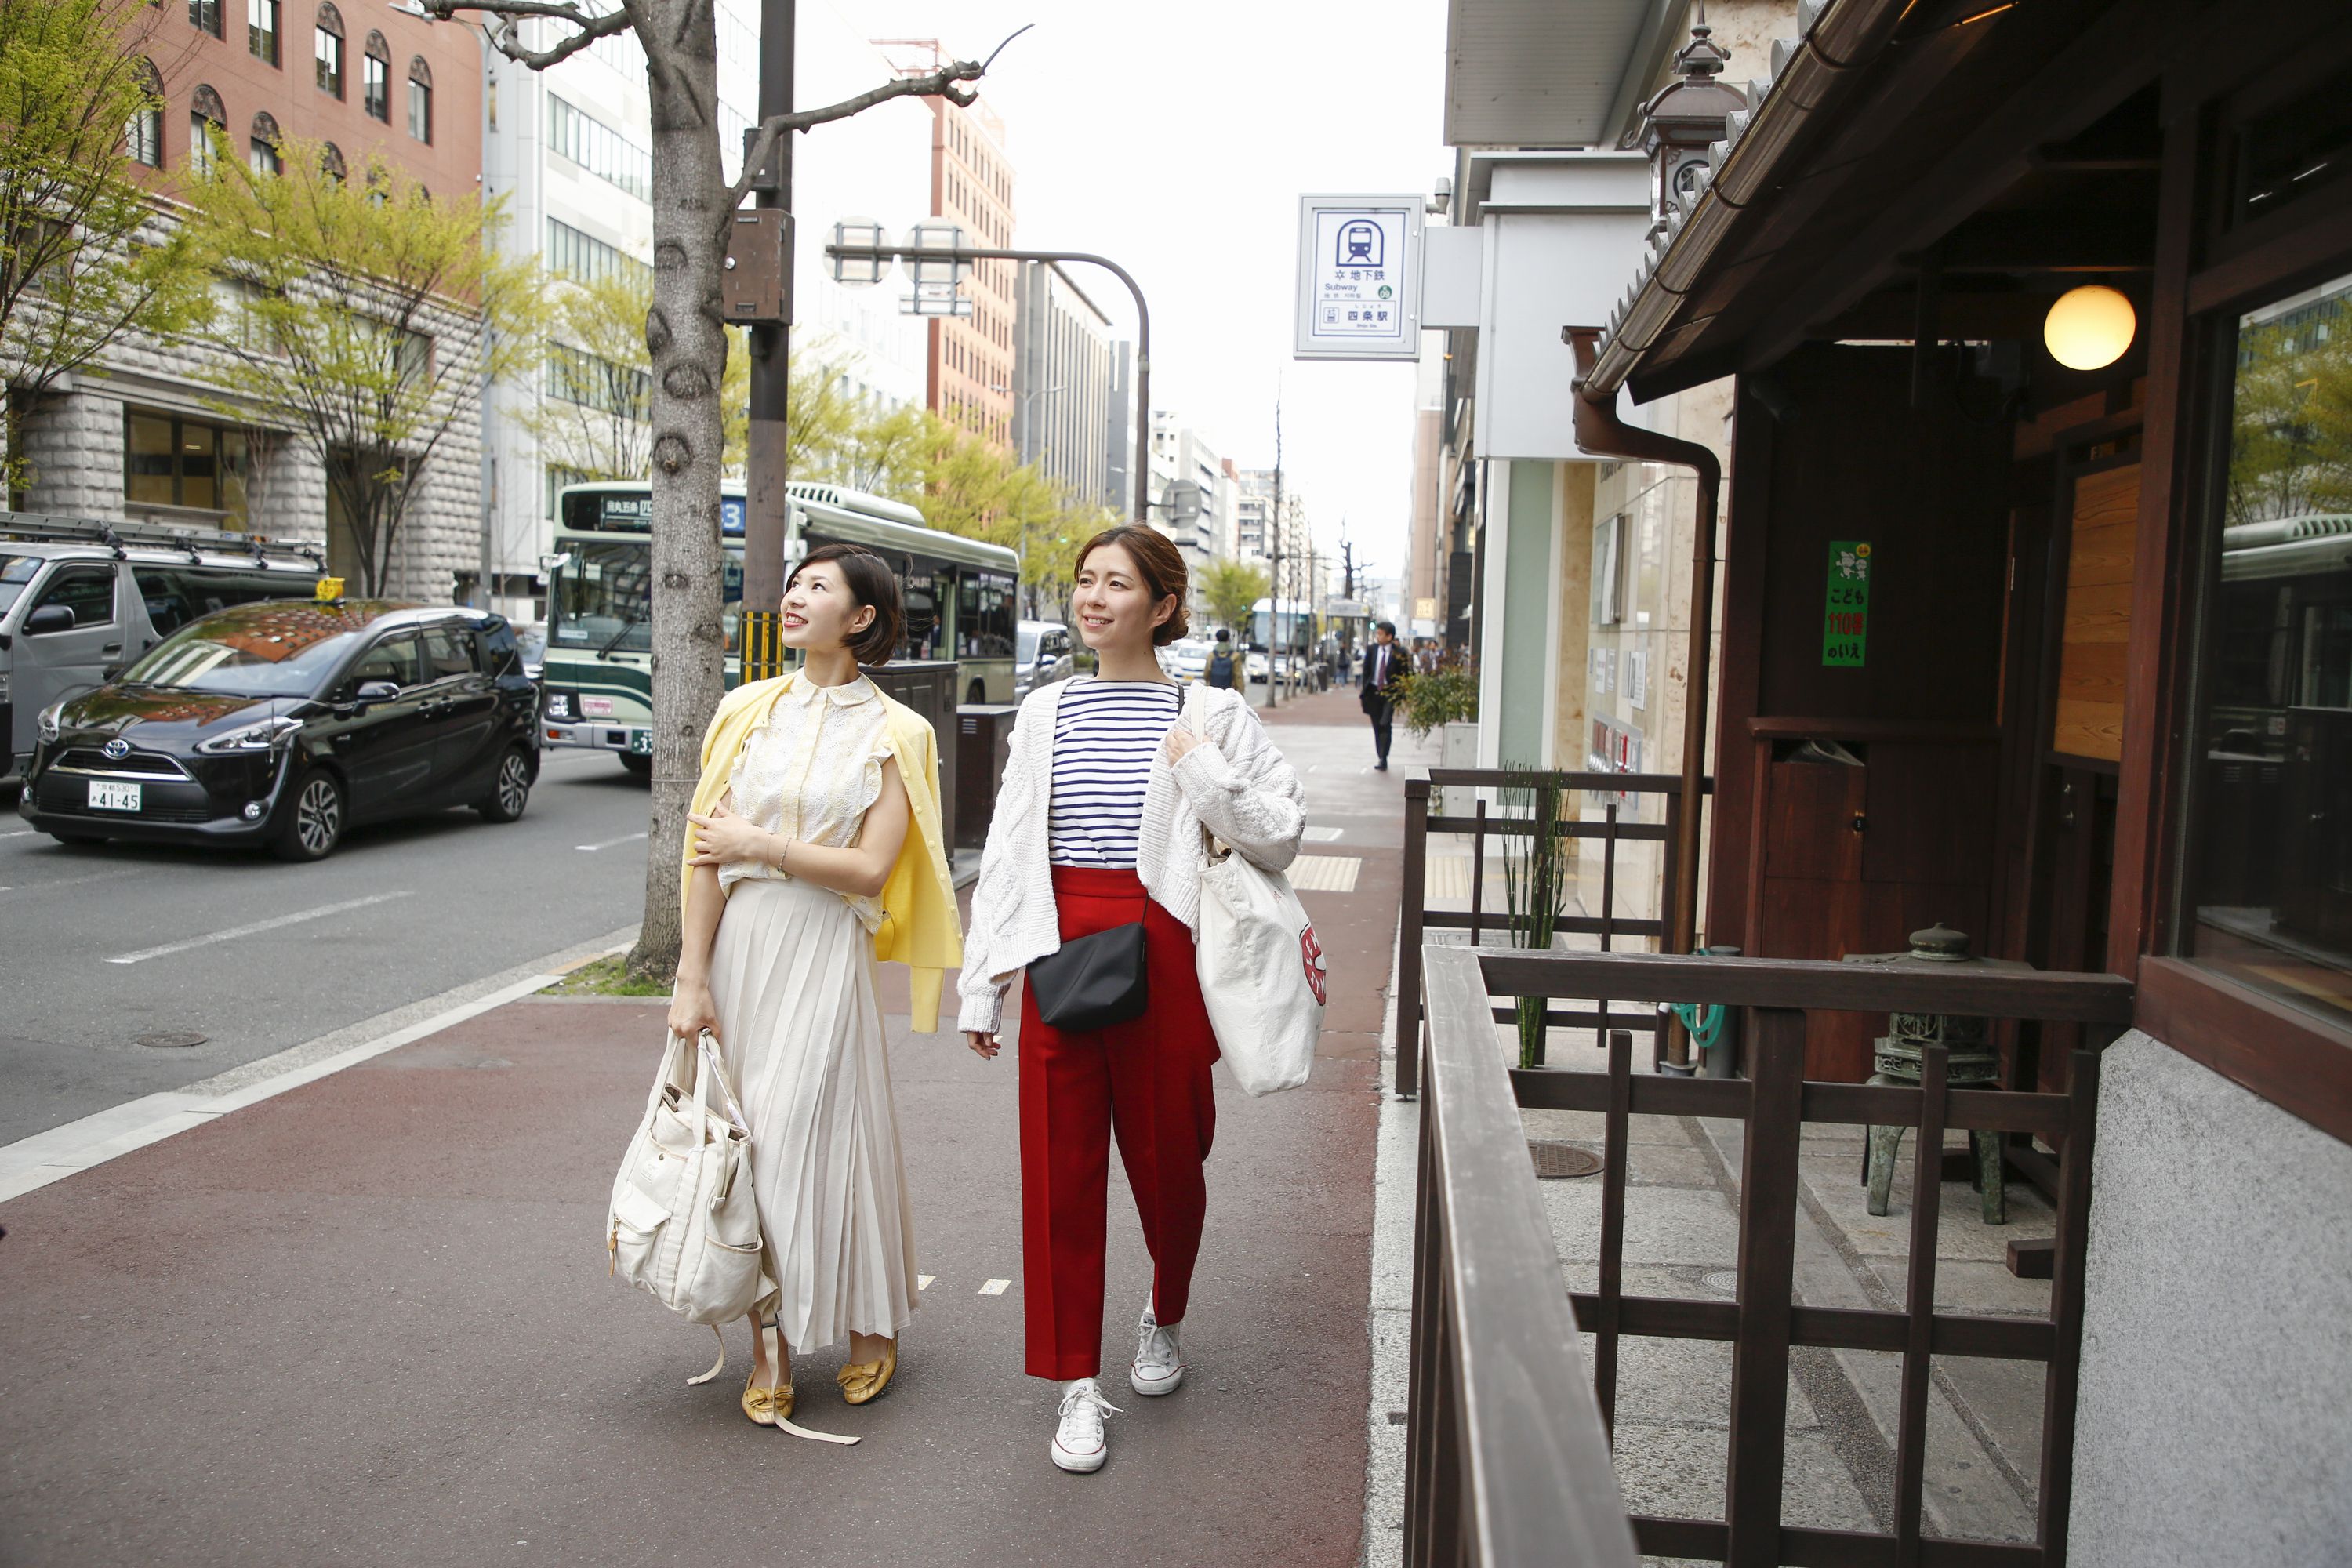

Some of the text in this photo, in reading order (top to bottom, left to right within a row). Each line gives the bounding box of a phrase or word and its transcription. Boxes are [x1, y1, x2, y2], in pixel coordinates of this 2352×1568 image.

[1350, 270, 1385, 281] 地下鉄
[1324, 283, 1358, 292] Subway
[1348, 310, 1388, 321] 四条駅
[1831, 588, 1864, 604] こども
[1828, 612, 1864, 635] 110番
[1828, 642, 1860, 659] のいえ
[100, 793, 138, 809] 41-45
